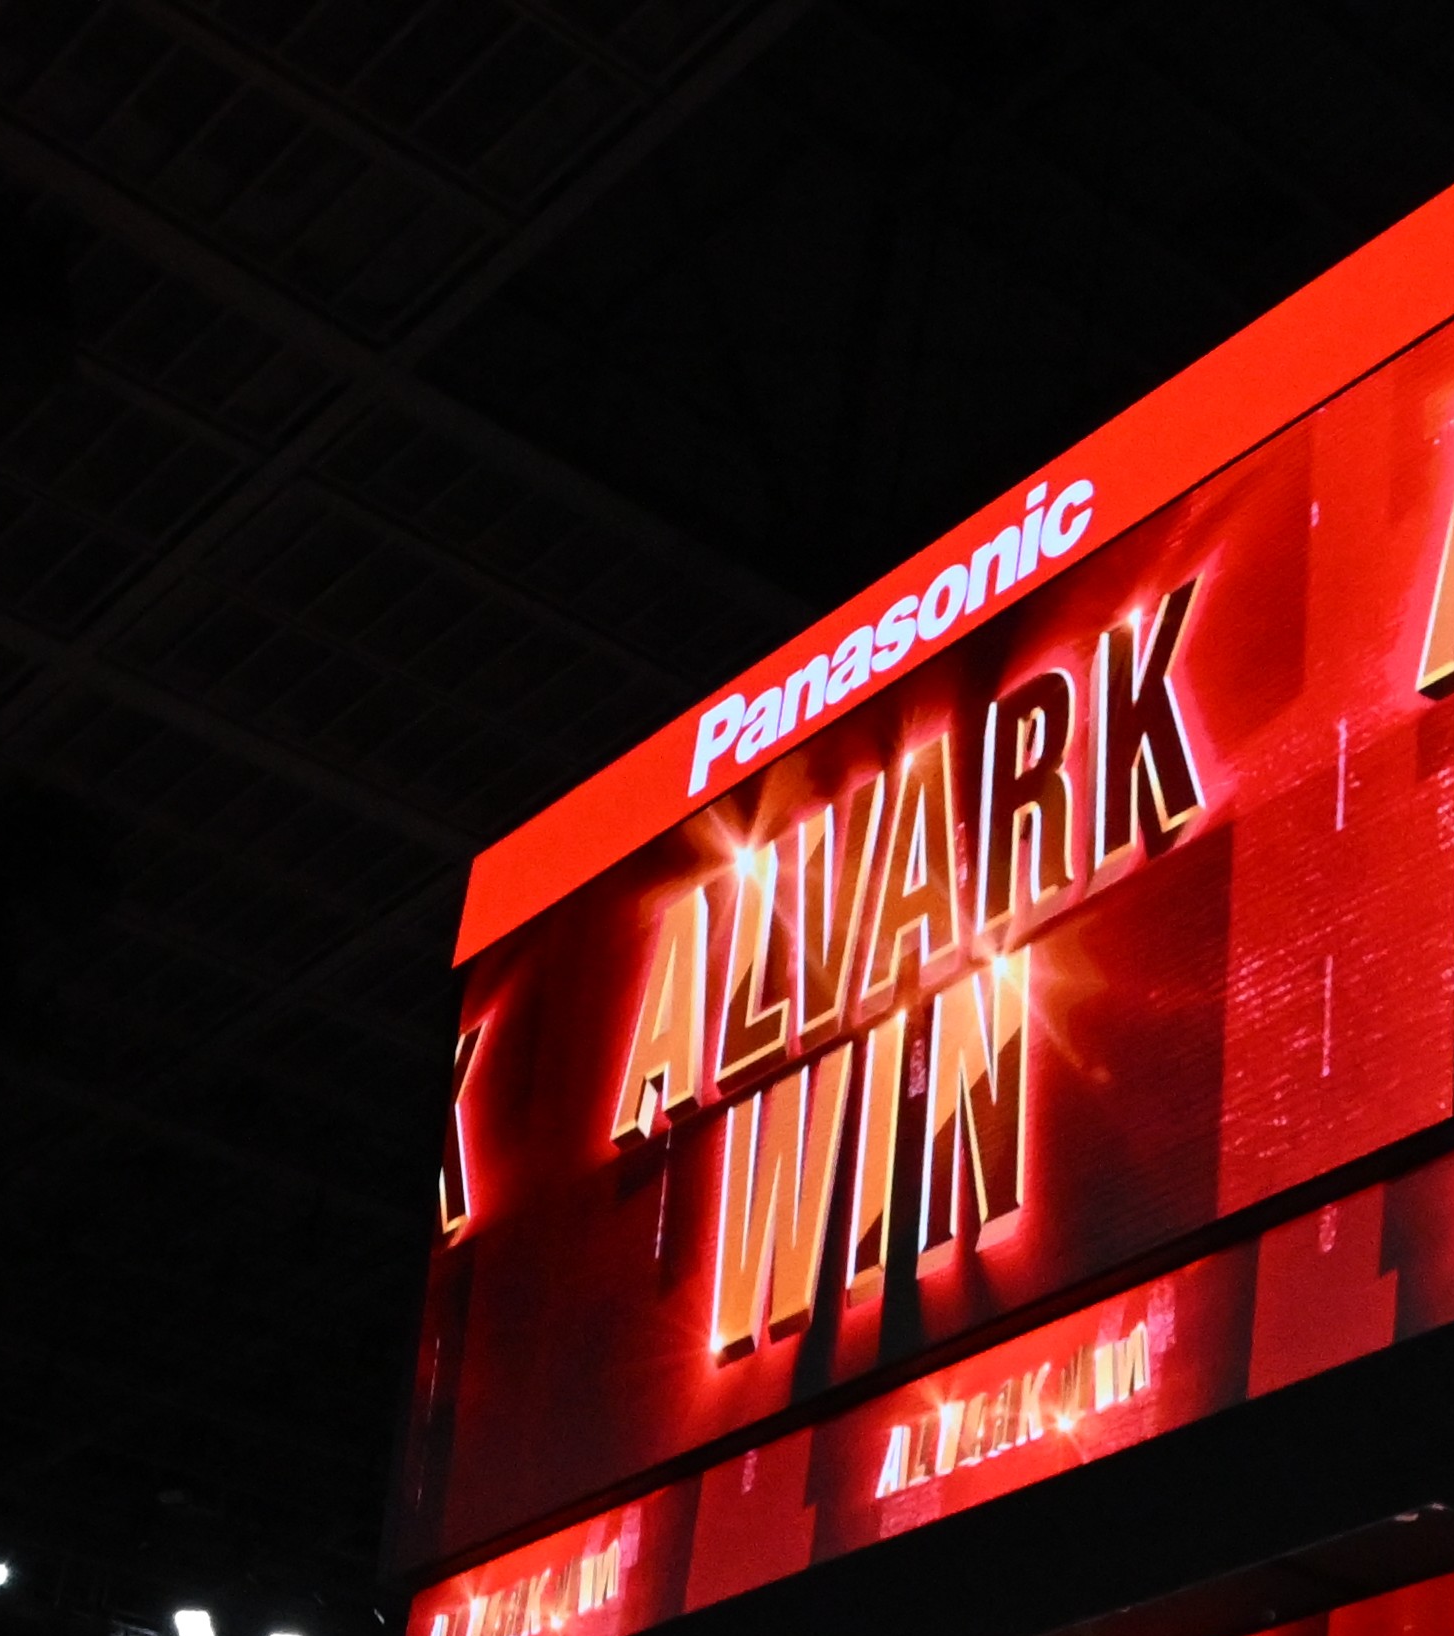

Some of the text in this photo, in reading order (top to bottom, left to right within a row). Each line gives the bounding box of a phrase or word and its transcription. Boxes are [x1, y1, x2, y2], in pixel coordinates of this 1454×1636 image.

[687, 479, 1094, 798] Panasonic
[609, 573, 1207, 1150] ALVARK
[709, 944, 1031, 1367] WIN
